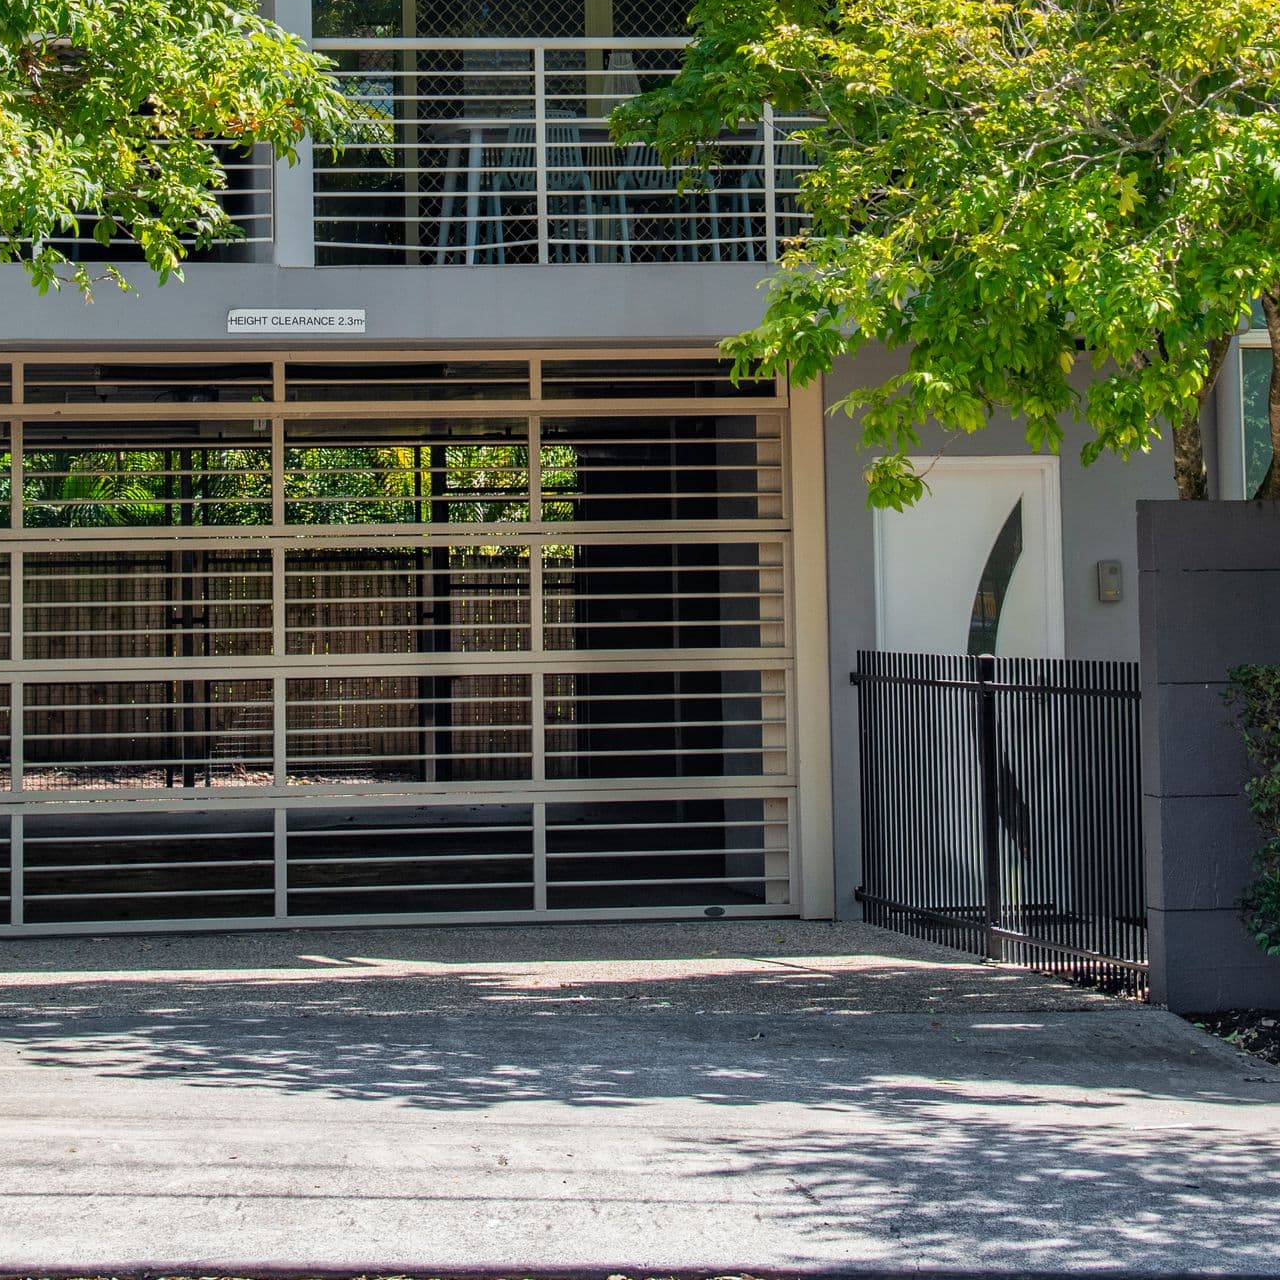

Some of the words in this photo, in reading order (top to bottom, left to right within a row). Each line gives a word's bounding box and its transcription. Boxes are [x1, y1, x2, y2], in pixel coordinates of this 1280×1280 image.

[230, 316, 268, 326] HEIGHT
[271, 316, 335, 326] CLEARANCE
[338, 316, 363, 326] 2.3m
